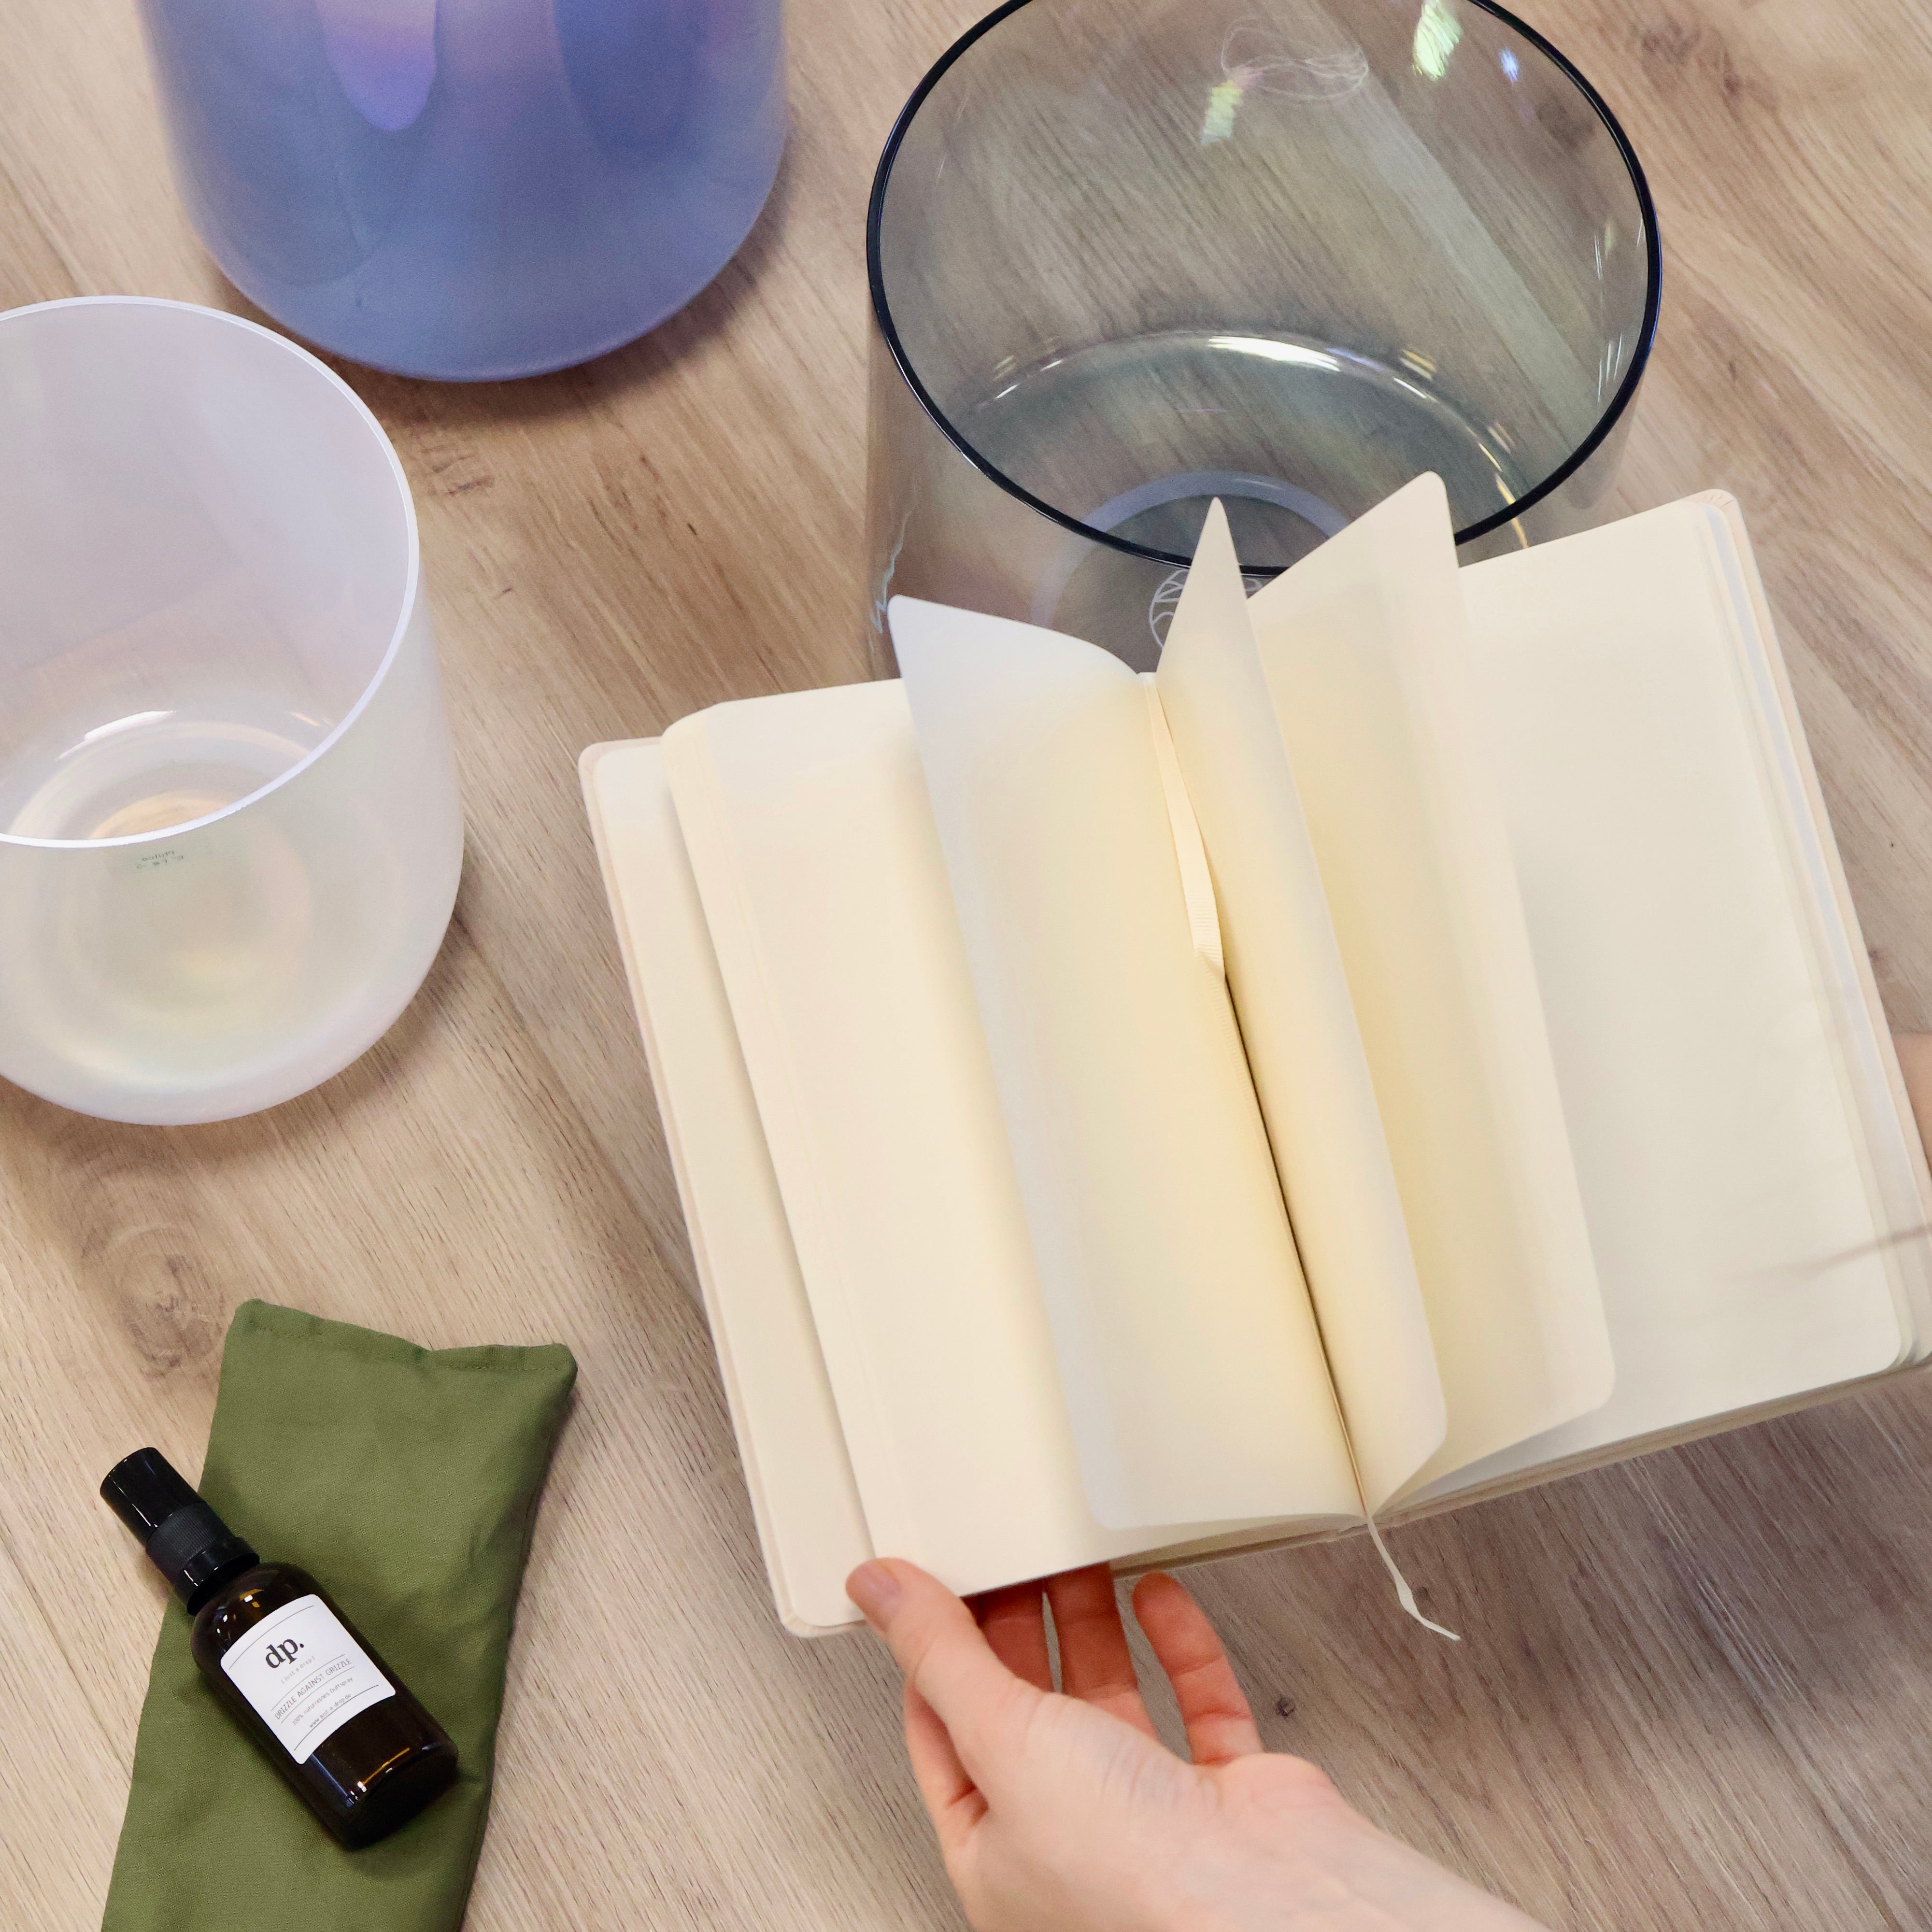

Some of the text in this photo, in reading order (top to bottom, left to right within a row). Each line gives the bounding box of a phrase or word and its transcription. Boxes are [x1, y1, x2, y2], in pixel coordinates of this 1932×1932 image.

[265, 1639, 305, 1669] dp.
[274, 1658, 352, 1720] DRIZZLE AGAINST GRIZZLE
[292, 1677, 354, 1726] 100% naturreines Duftspray
[309, 1693, 352, 1728] wwwjust-a-dropde
